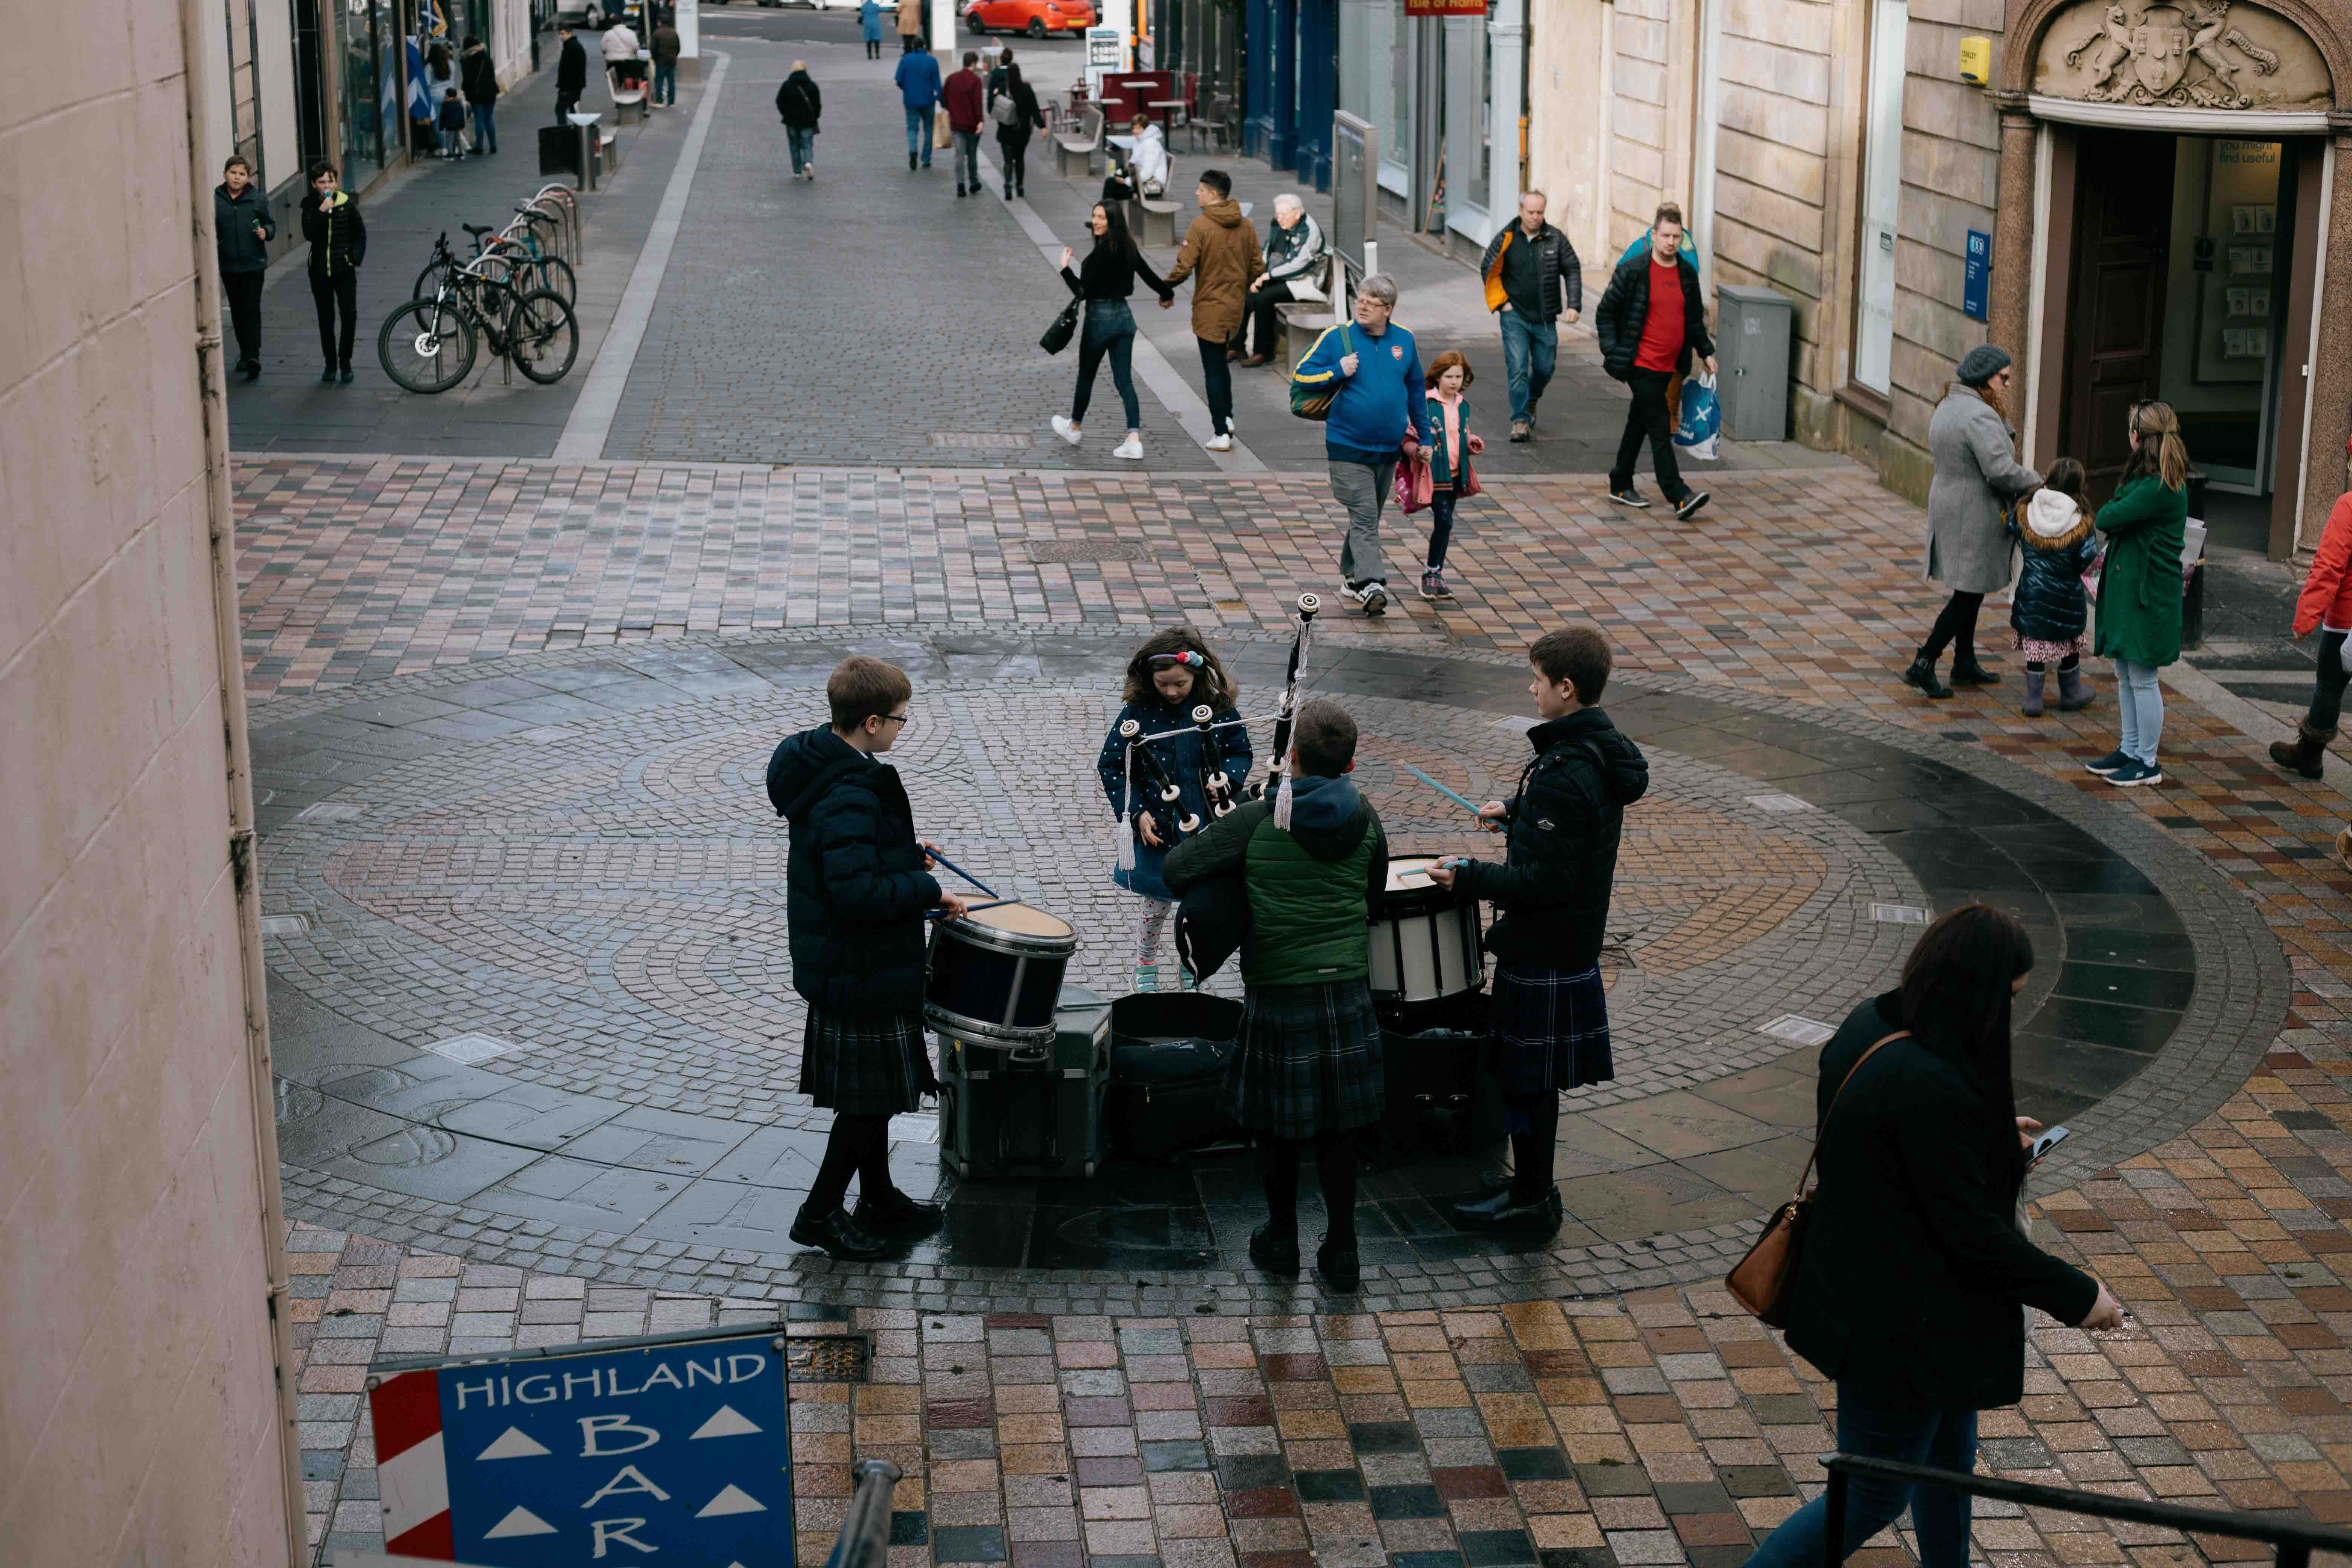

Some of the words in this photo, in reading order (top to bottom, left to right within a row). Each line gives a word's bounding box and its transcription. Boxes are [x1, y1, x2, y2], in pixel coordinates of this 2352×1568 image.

[2219, 151, 2239, 163] find
[2242, 151, 2275, 163] useful
[456, 1354, 766, 1410] HIGHLAND
[576, 1415, 669, 1568] BAR
